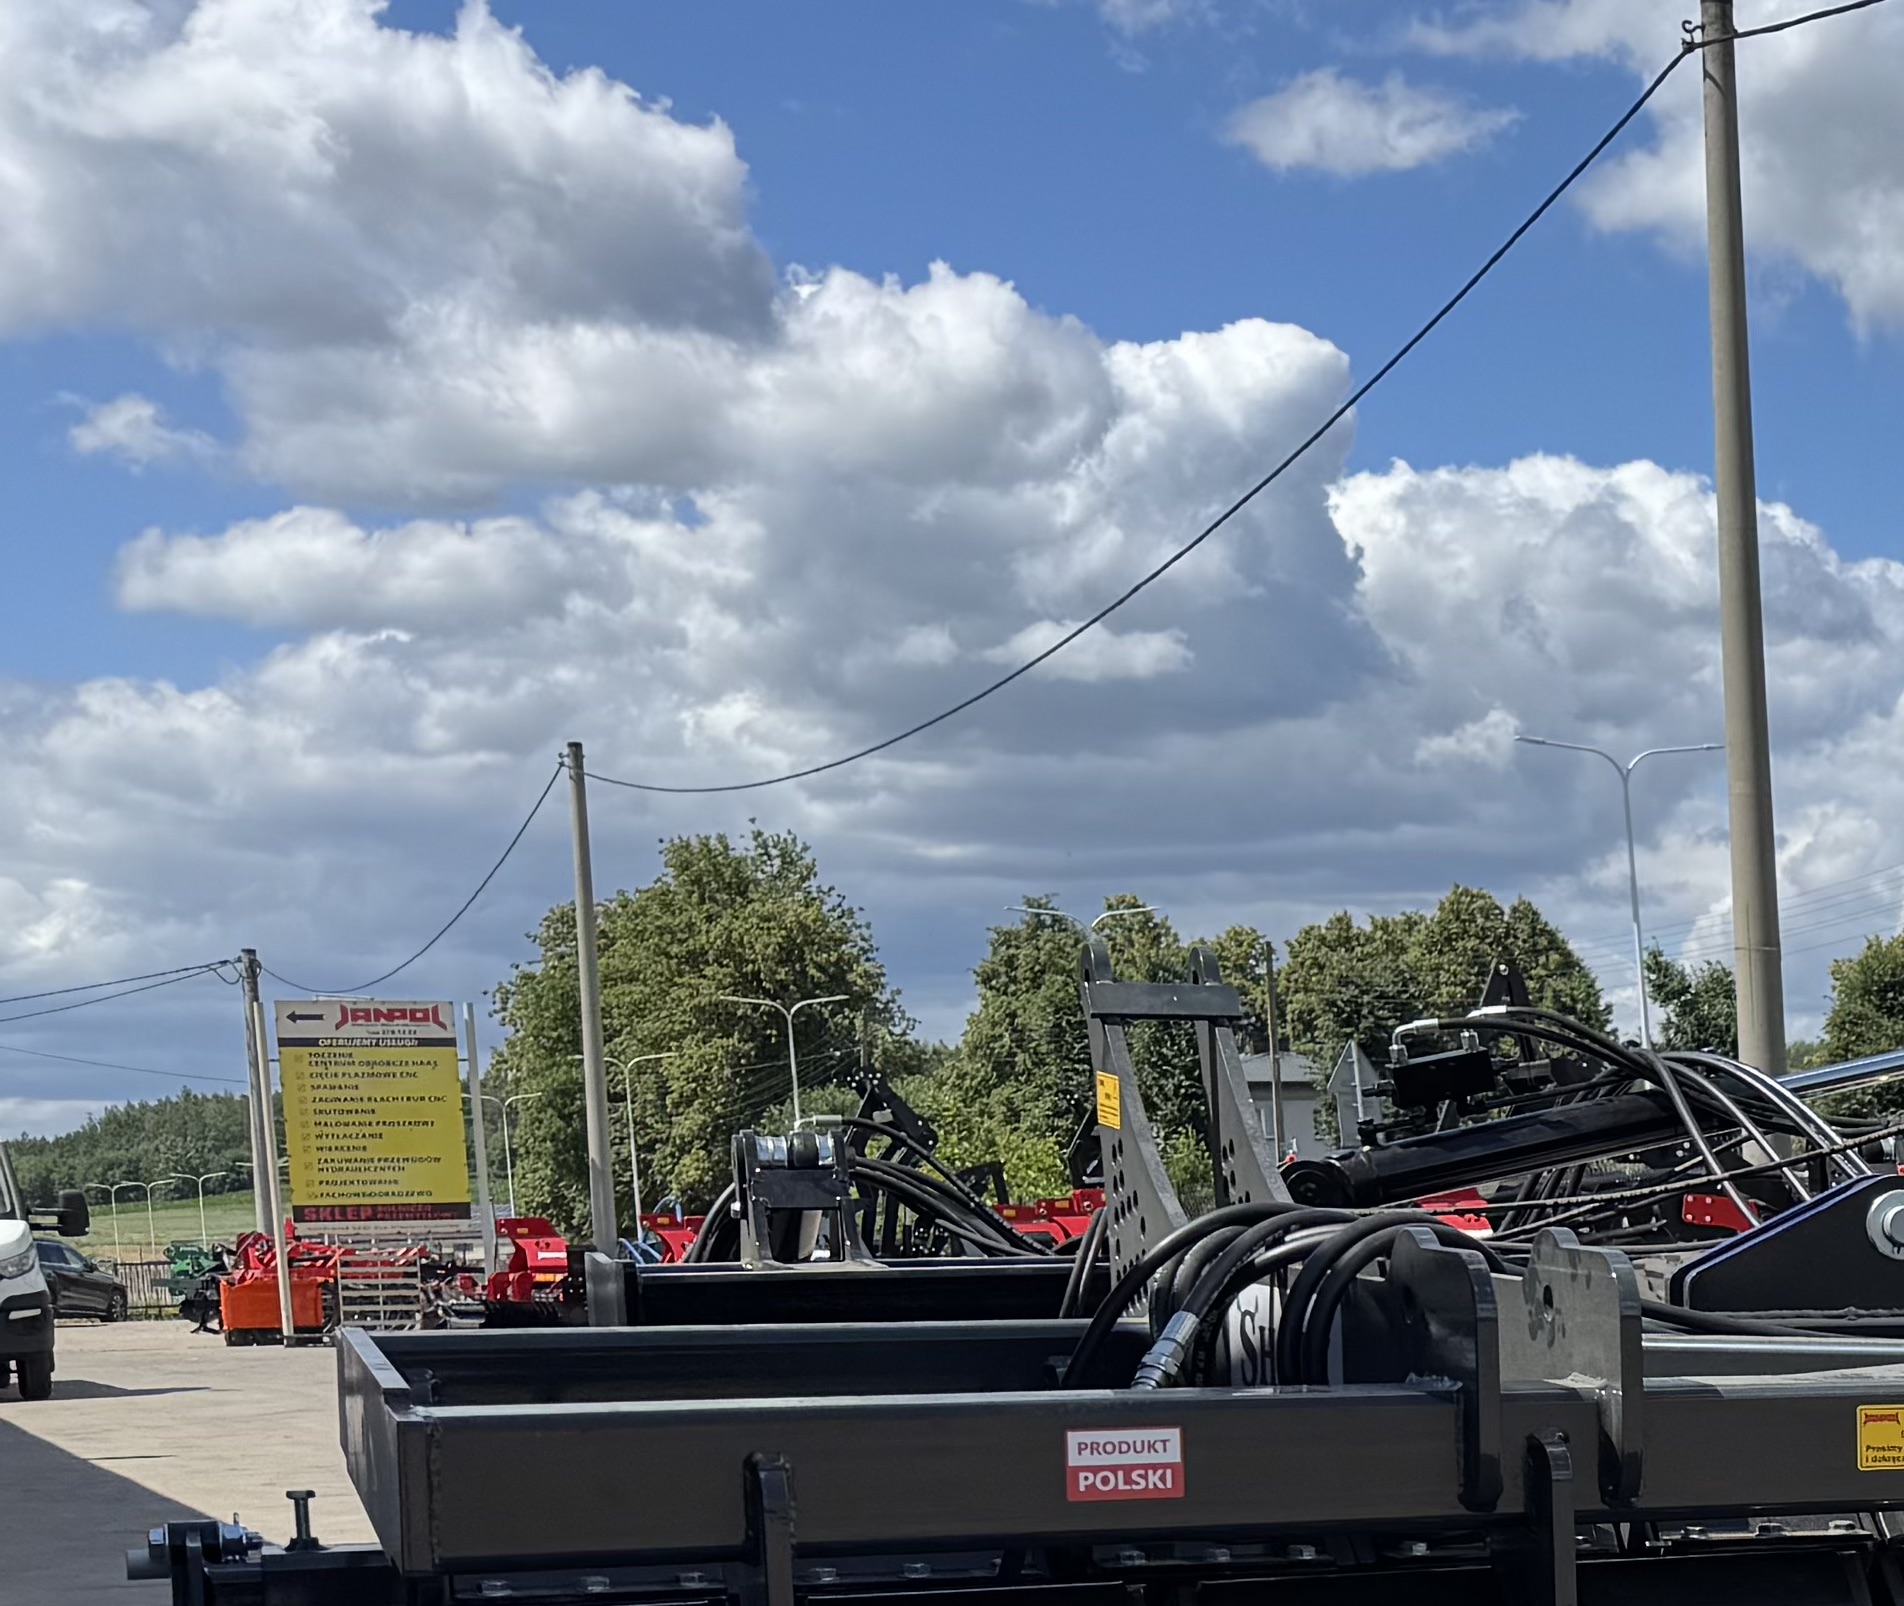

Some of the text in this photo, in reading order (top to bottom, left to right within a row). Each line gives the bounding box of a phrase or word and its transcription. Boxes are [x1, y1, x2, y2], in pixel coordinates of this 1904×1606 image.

[335, 1004, 448, 1031] JANPOL
[304, 1206, 374, 1221] SKLEP
[1077, 1438, 1171, 1456] PRODUKT
[1078, 1468, 1173, 1492] POLSKI
